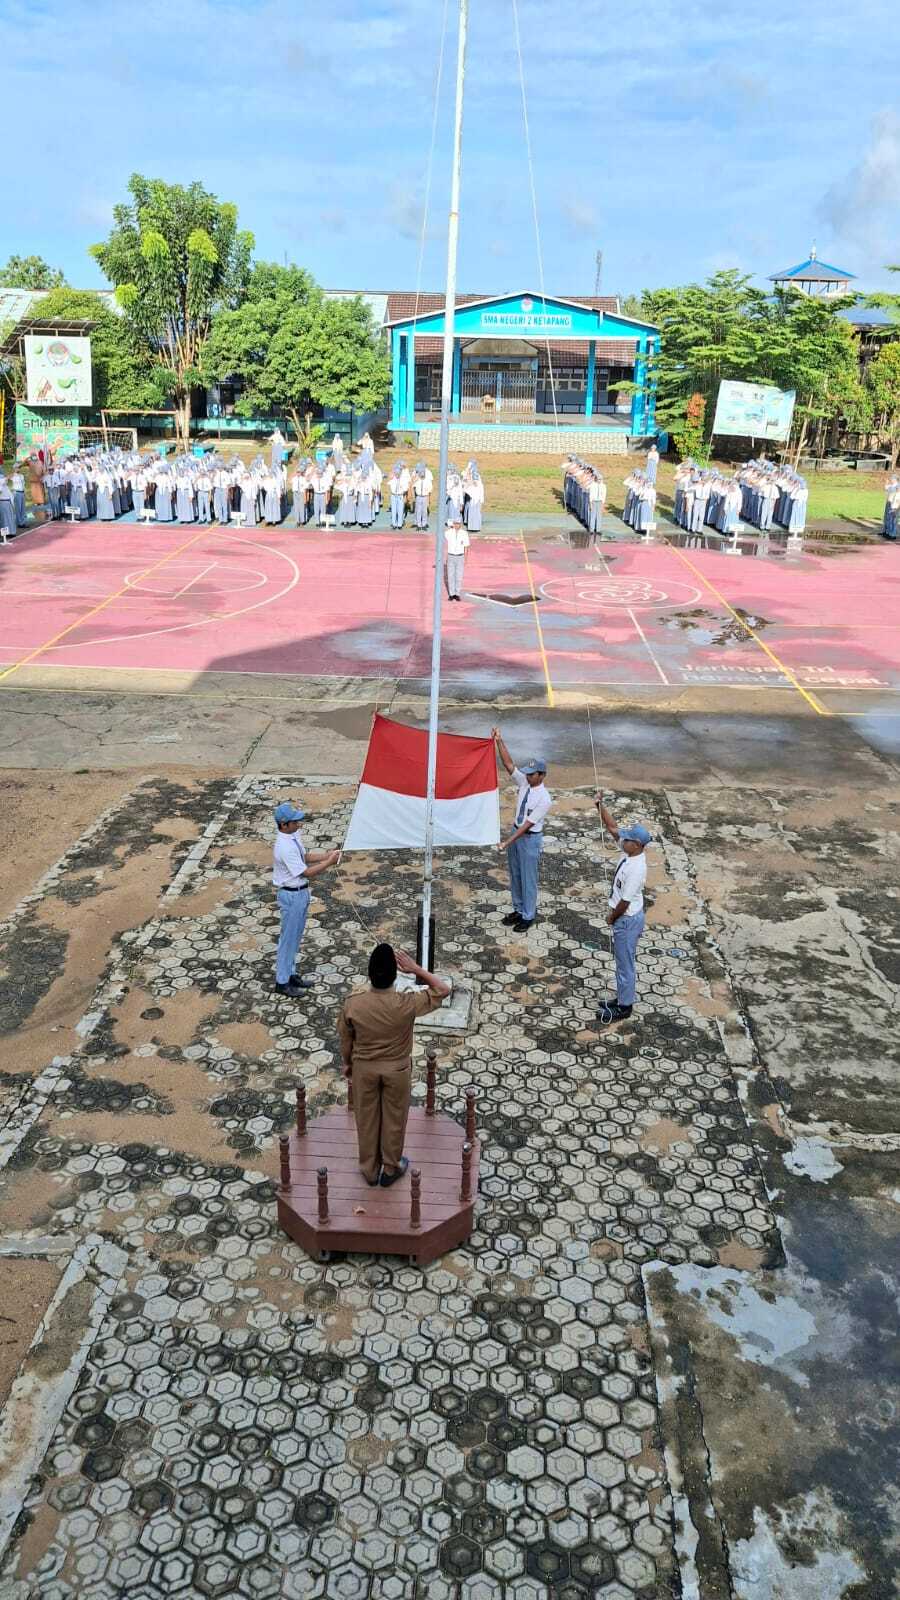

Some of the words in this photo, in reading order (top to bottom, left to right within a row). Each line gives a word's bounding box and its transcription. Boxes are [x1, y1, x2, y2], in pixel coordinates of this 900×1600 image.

[484, 314, 498, 324] SMA
[500, 315, 526, 325] NEGERI
[534, 316, 570, 326] KETAPANG
